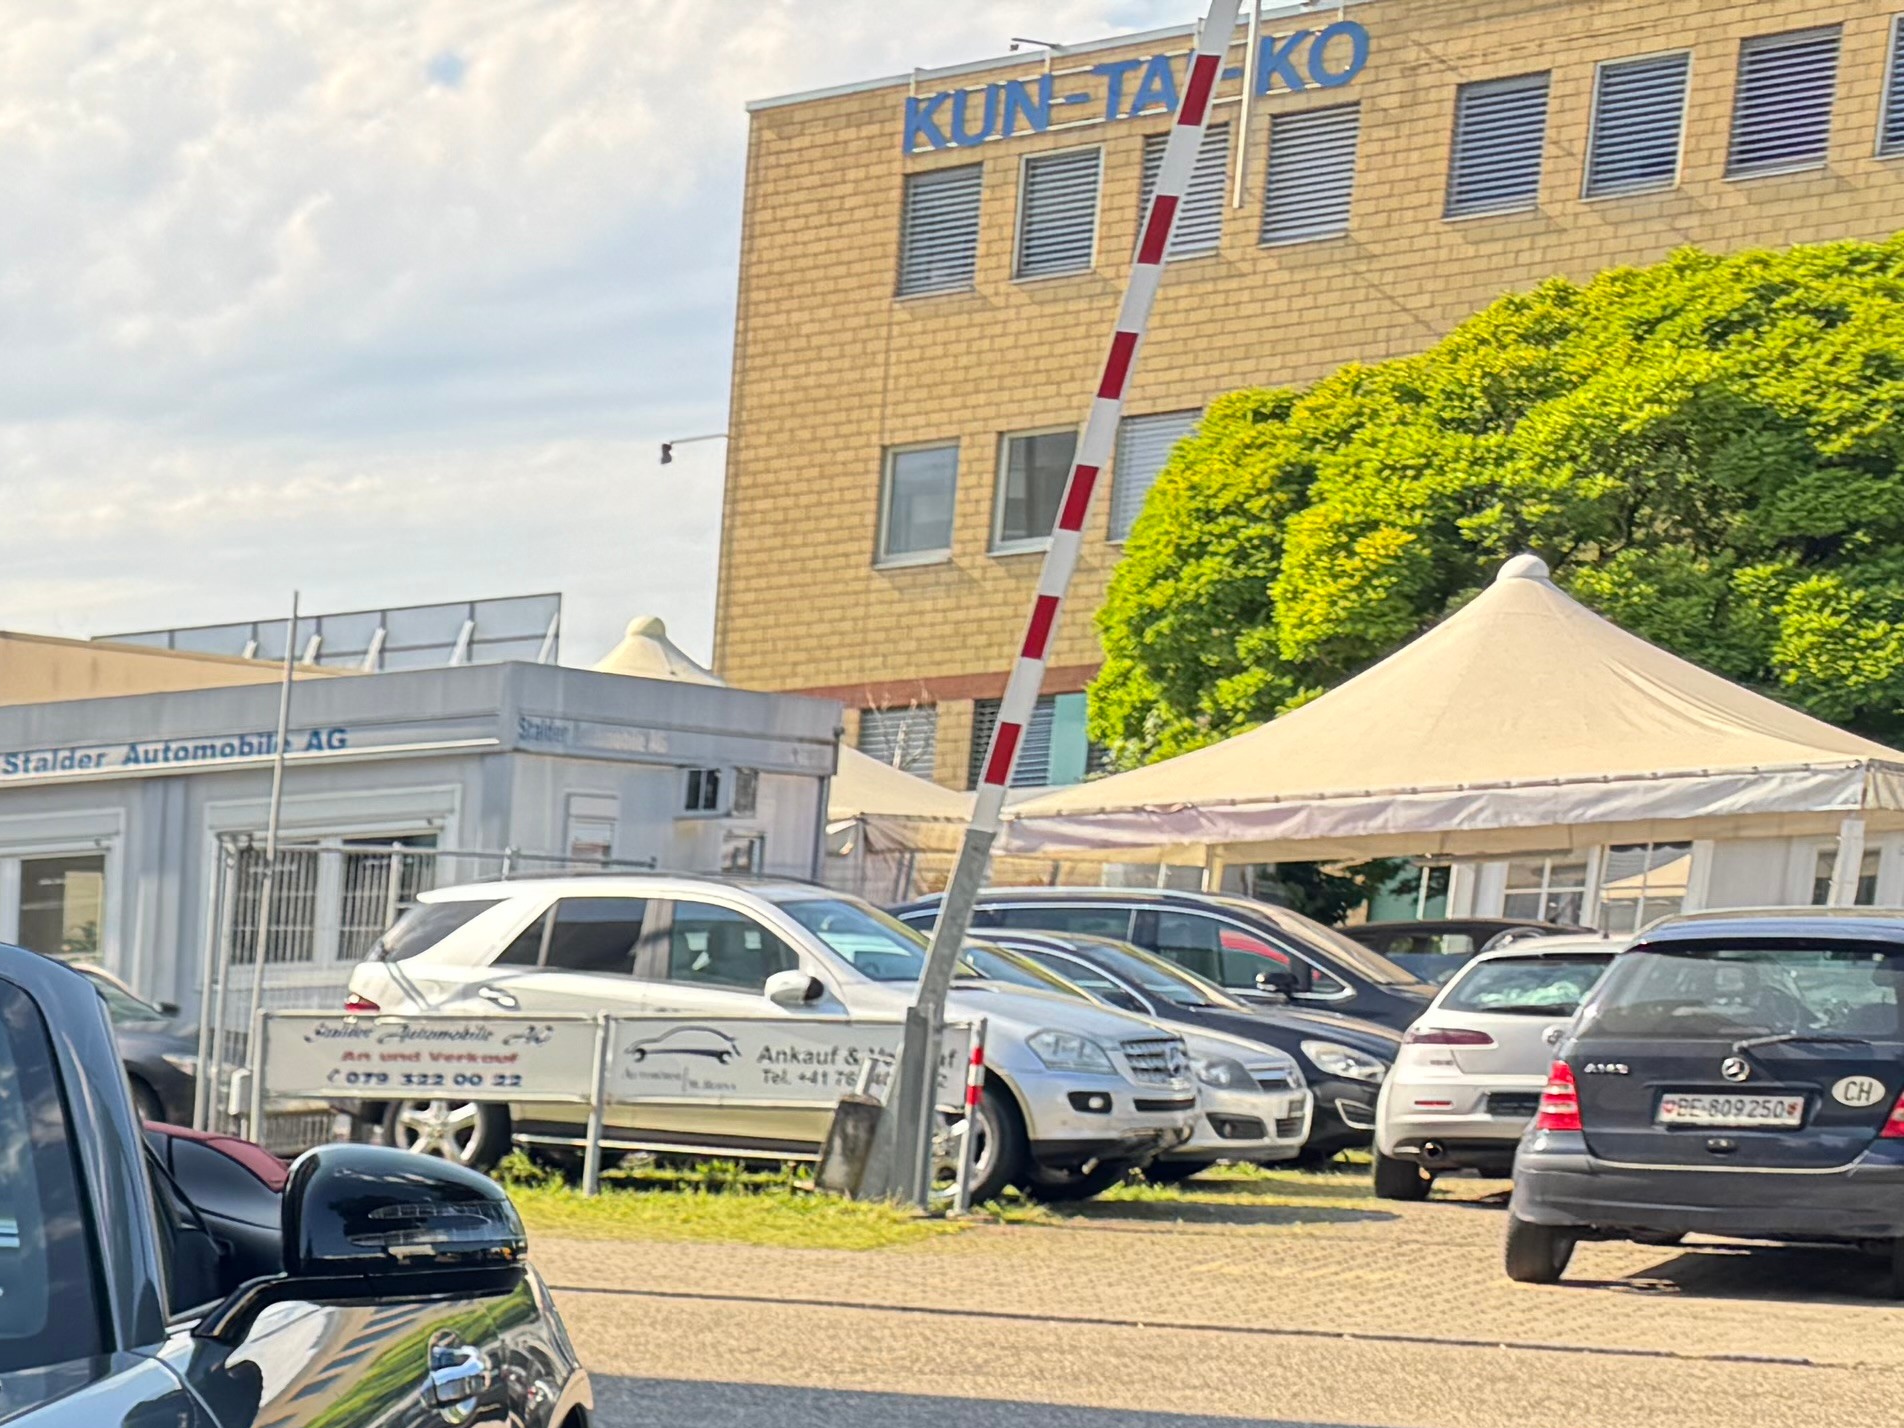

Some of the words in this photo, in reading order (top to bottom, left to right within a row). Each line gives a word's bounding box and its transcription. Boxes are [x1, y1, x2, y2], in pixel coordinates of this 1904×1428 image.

[903, 20, 1371, 155] KUN-TA-KO
[1, 750, 109, 775] Stalder
[304, 728, 349, 751] AG
[342, 1051, 371, 1062] An
[380, 1051, 421, 1063] und
[429, 1052, 519, 1065] Verkauf
[756, 1045, 839, 1066] Ankauf
[346, 1071, 389, 1085] 079
[453, 1072, 483, 1087] 00
[493, 1073, 523, 1088] 22
[1842, 1080, 1873, 1101] CH
